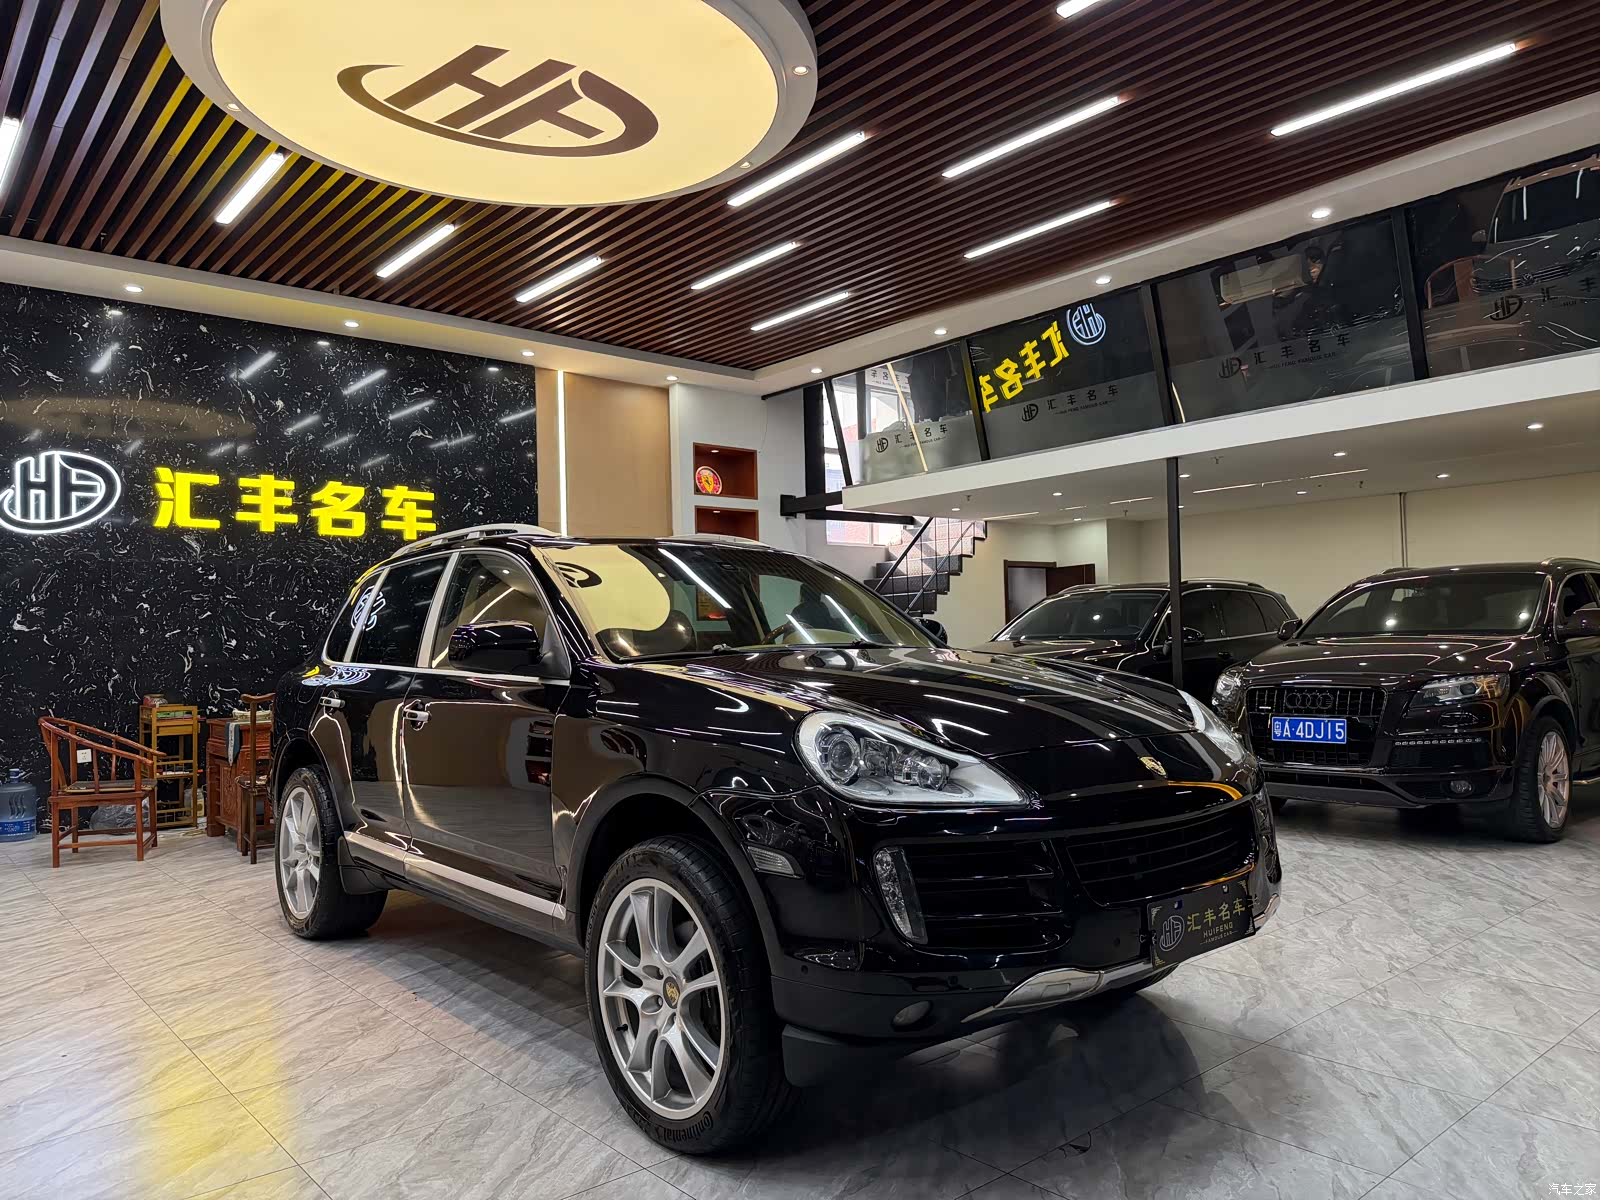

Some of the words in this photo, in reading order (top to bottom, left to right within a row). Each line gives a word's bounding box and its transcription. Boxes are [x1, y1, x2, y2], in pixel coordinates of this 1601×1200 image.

[1254, 334, 1350, 365] 汇丰名车
[1047, 385, 1118, 411] 汇丰名车
[152, 466, 437, 540] 汇丰名车
[1187, 897, 1245, 932] 汇丰名车
[1203, 921, 1233, 939] HUIFENG
[663, 1110, 714, 1143] Continental
